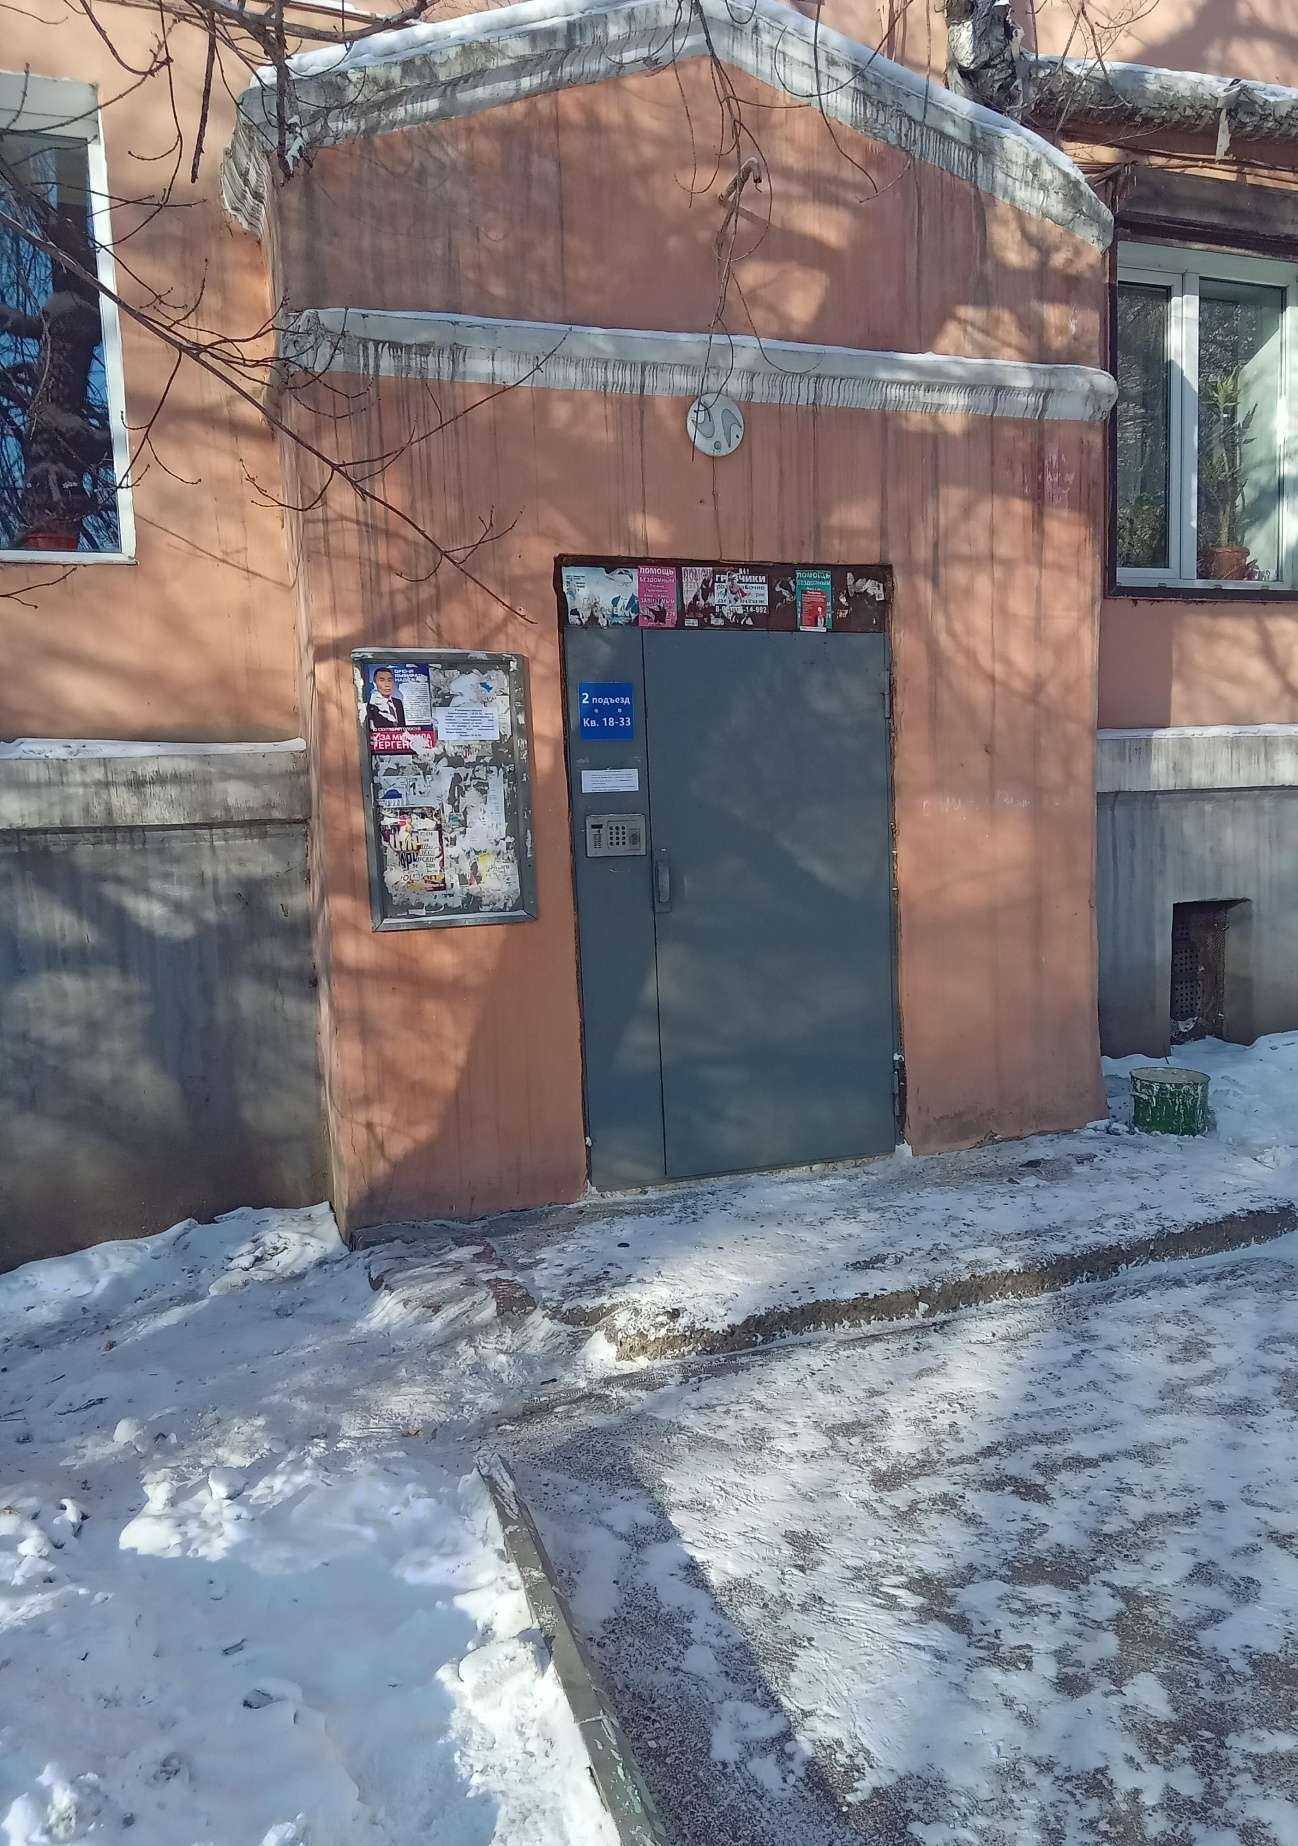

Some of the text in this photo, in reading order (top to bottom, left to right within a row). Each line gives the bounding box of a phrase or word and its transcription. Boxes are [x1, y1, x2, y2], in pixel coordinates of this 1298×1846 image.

[639, 568, 674, 577] ПОМОЩЬ
[796, 571, 831, 580] ПОМОЩЬ
[581, 692, 631, 706] 2 подъезд
[583, 717, 631, 727] Кв. 18-33
